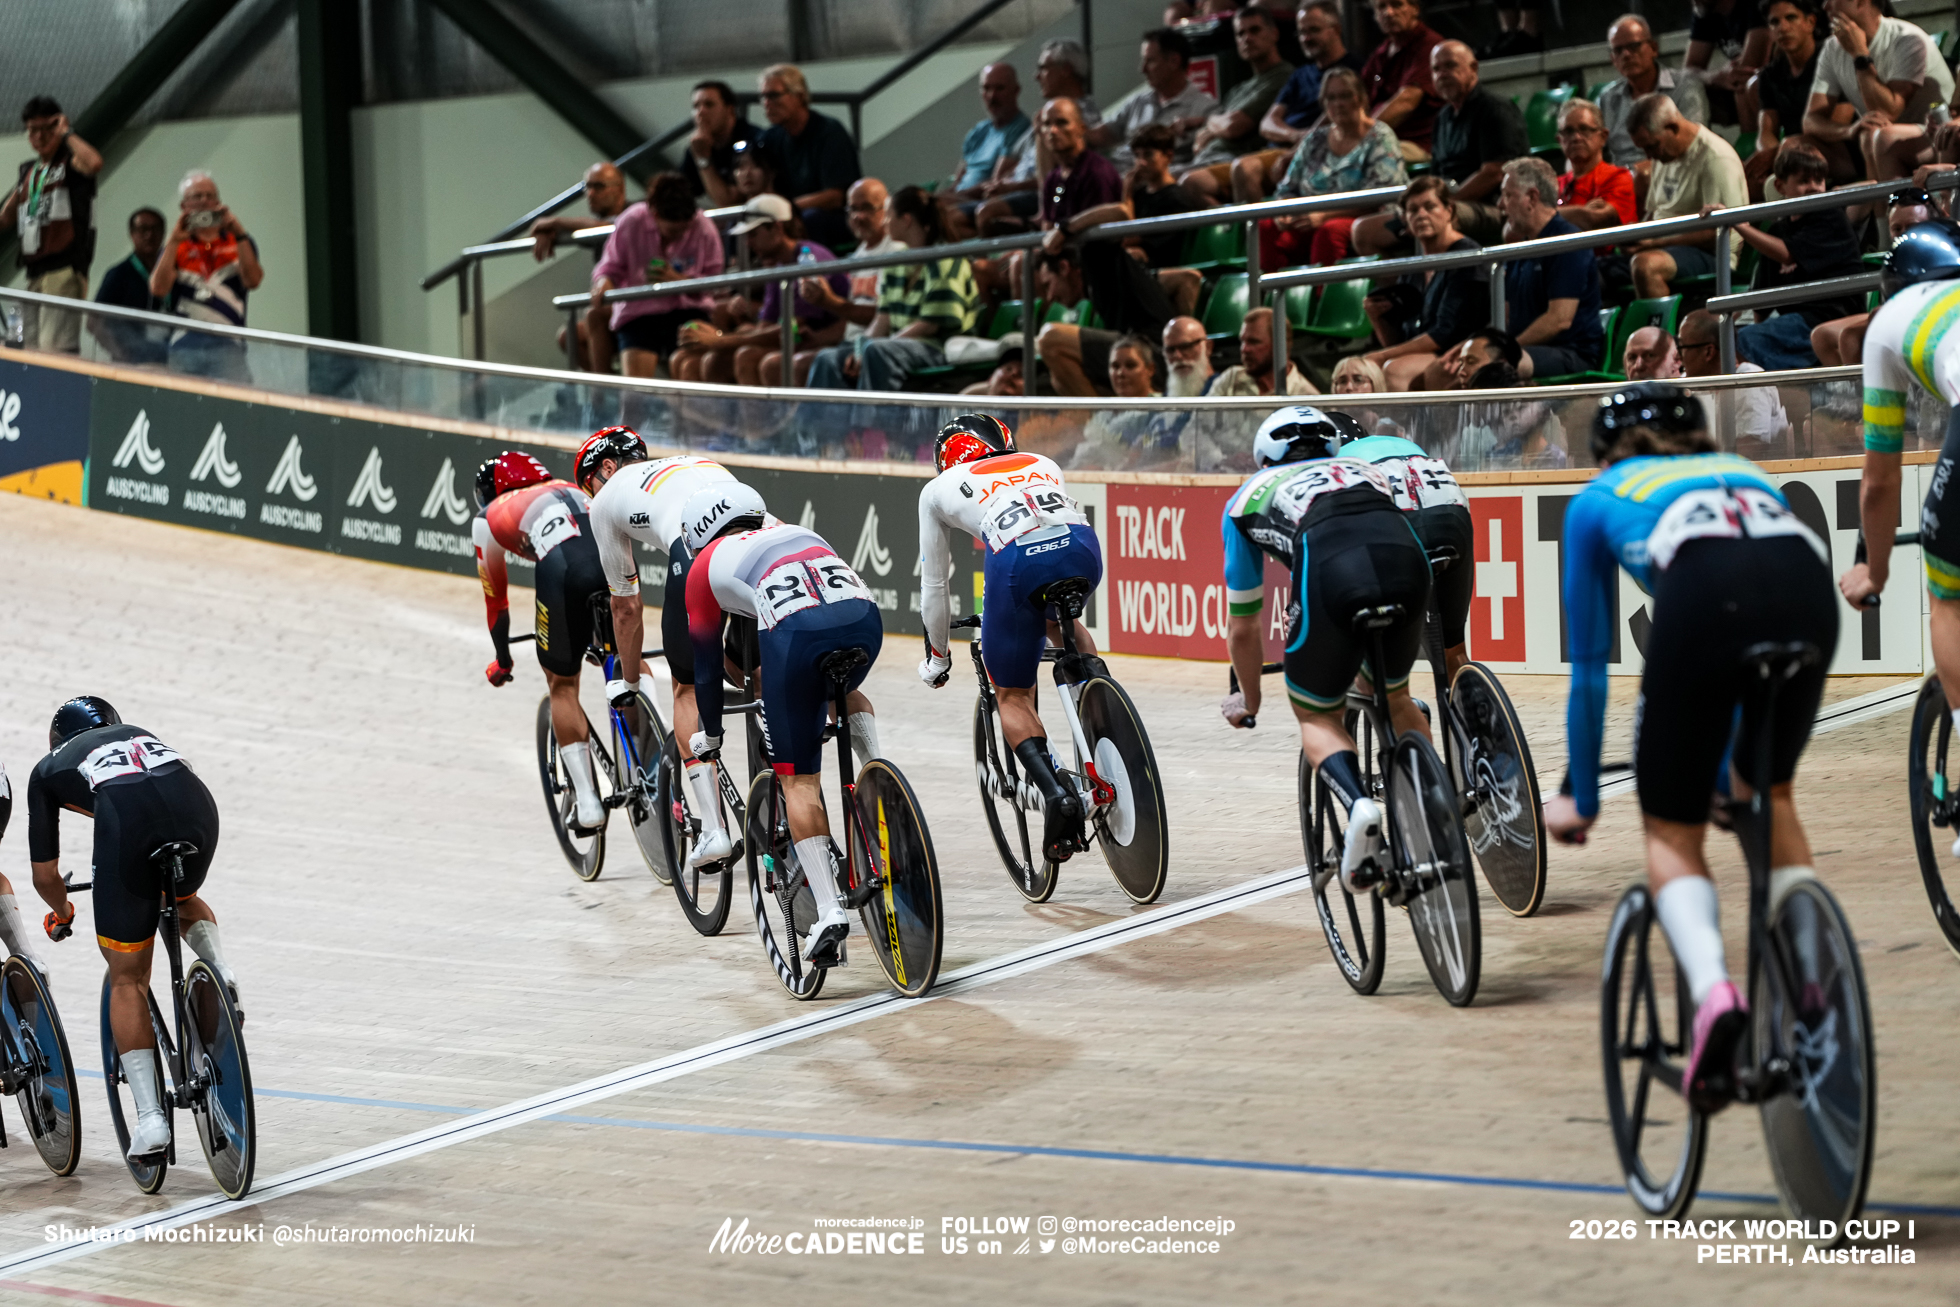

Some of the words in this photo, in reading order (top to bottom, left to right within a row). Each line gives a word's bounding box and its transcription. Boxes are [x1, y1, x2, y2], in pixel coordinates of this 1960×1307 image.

[105, 476, 169, 505] AUSCYCLING
[979, 472, 1059, 504] JAPAN
[1035, 492, 1069, 514] 15
[183, 489, 246, 519] AUSCYCLING
[260, 503, 322, 533] AUSCYCLING
[629, 512, 650, 525] KTM
[693, 499, 732, 538] KASK
[994, 500, 1031, 531] 15
[341, 517, 401, 546] AUSCYCLING
[415, 529, 475, 557] AUSCYCLING
[1025, 537, 1071, 556] Q36.5
[1116, 506, 1186, 560] TRACK
[820, 565, 861, 589] 21
[765, 576, 806, 610] 21
[535, 598, 549, 651] CHINA
[1118, 580, 1197, 637] WORLD
[1202, 584, 1228, 639] CU
[94, 748, 129, 772] 17
[886, 904, 905, 981] MAVIC
